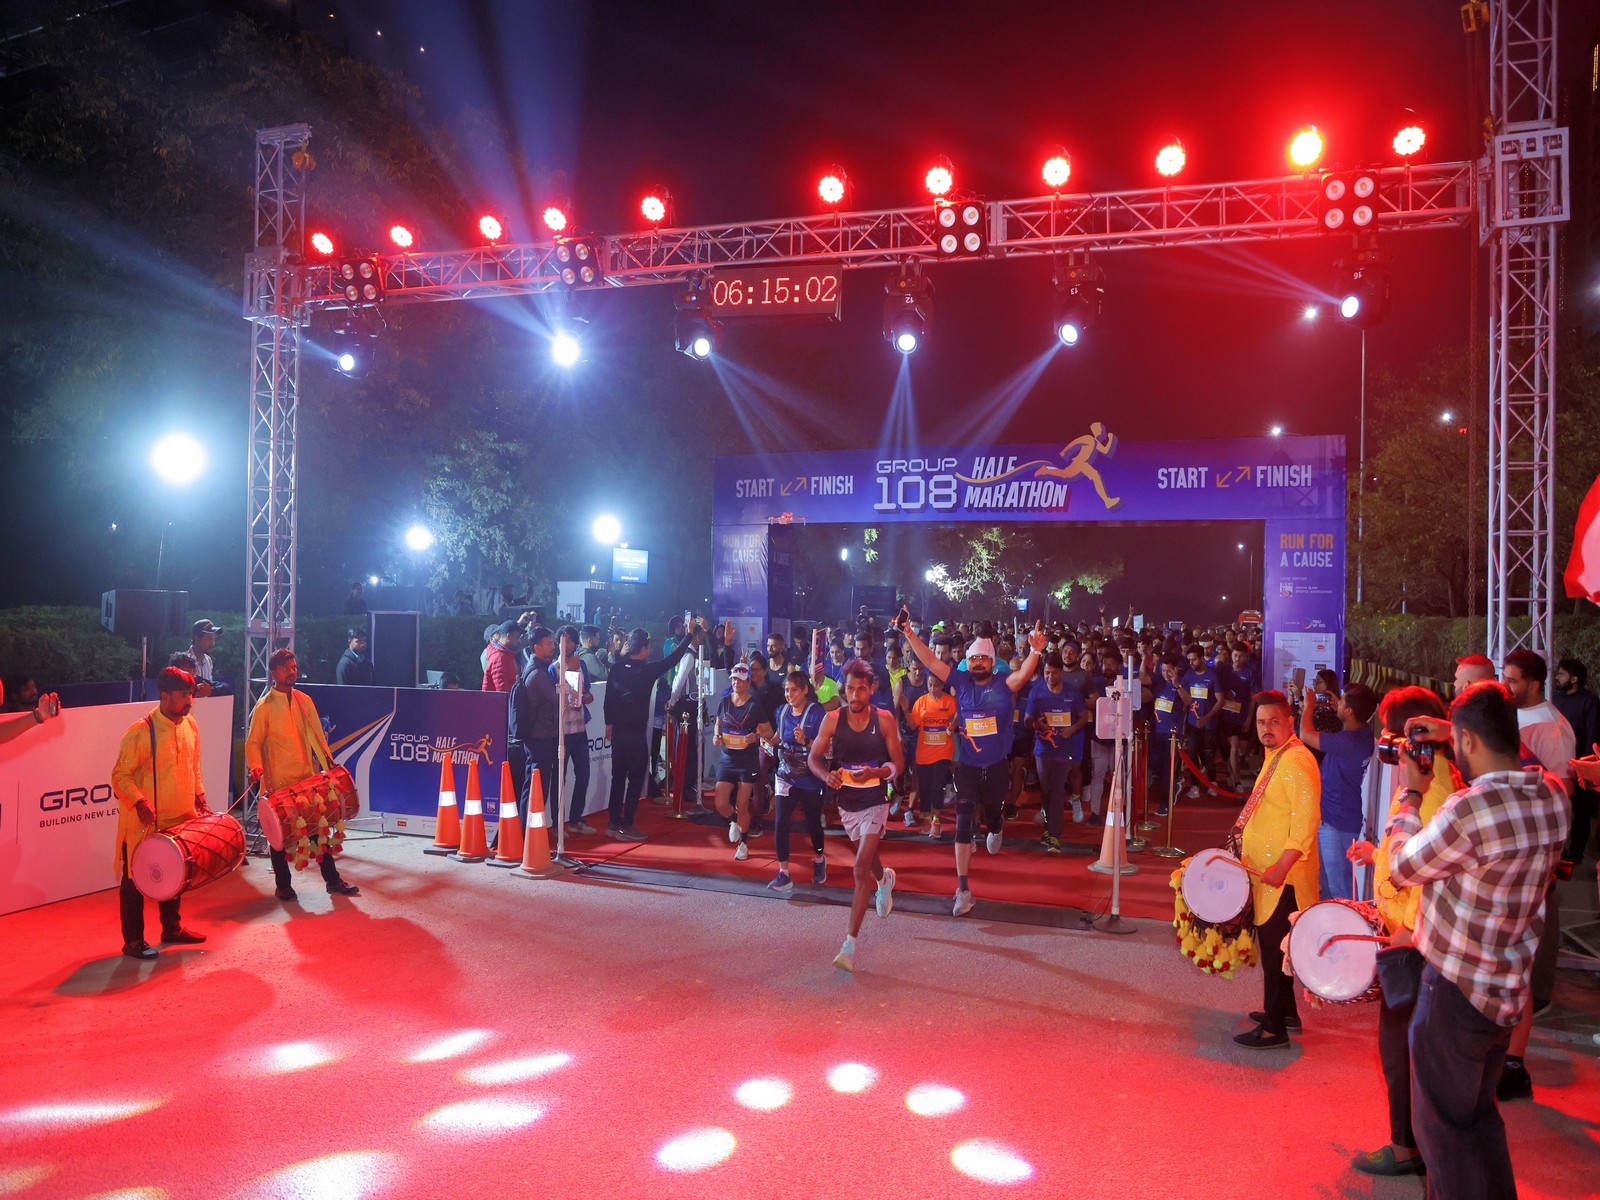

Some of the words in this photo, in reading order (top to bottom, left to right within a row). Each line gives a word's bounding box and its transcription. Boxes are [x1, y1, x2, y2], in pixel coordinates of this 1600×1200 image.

[713, 275, 837, 305] 06:15:02
[876, 458, 958, 473] GROUP
[971, 456, 1017, 480] HALF
[1157, 467, 1208, 489] START
[1256, 464, 1312, 487] FINISH
[735, 478, 774, 498] START
[810, 475, 853, 495] FINISH
[873, 475, 958, 510] 108
[964, 481, 1068, 508] MARATHON
[722, 534, 740, 547] RUN
[743, 534, 760, 547] FOR
[1280, 533, 1305, 549] RUN
[1309, 533, 1334, 549] FOR
[733, 549, 760, 562] CAUSE
[1280, 552, 1289, 567] A
[1293, 551, 1334, 568] CAUSE
[390, 733, 430, 743] GROUP
[435, 736, 457, 749] HALF
[389, 742, 429, 762] 108
[432, 750, 480, 765] MAATHON
[40, 784, 119, 812] GRO
[40, 814, 82, 828] BUILDING
[84, 811, 104, 820] NEW
